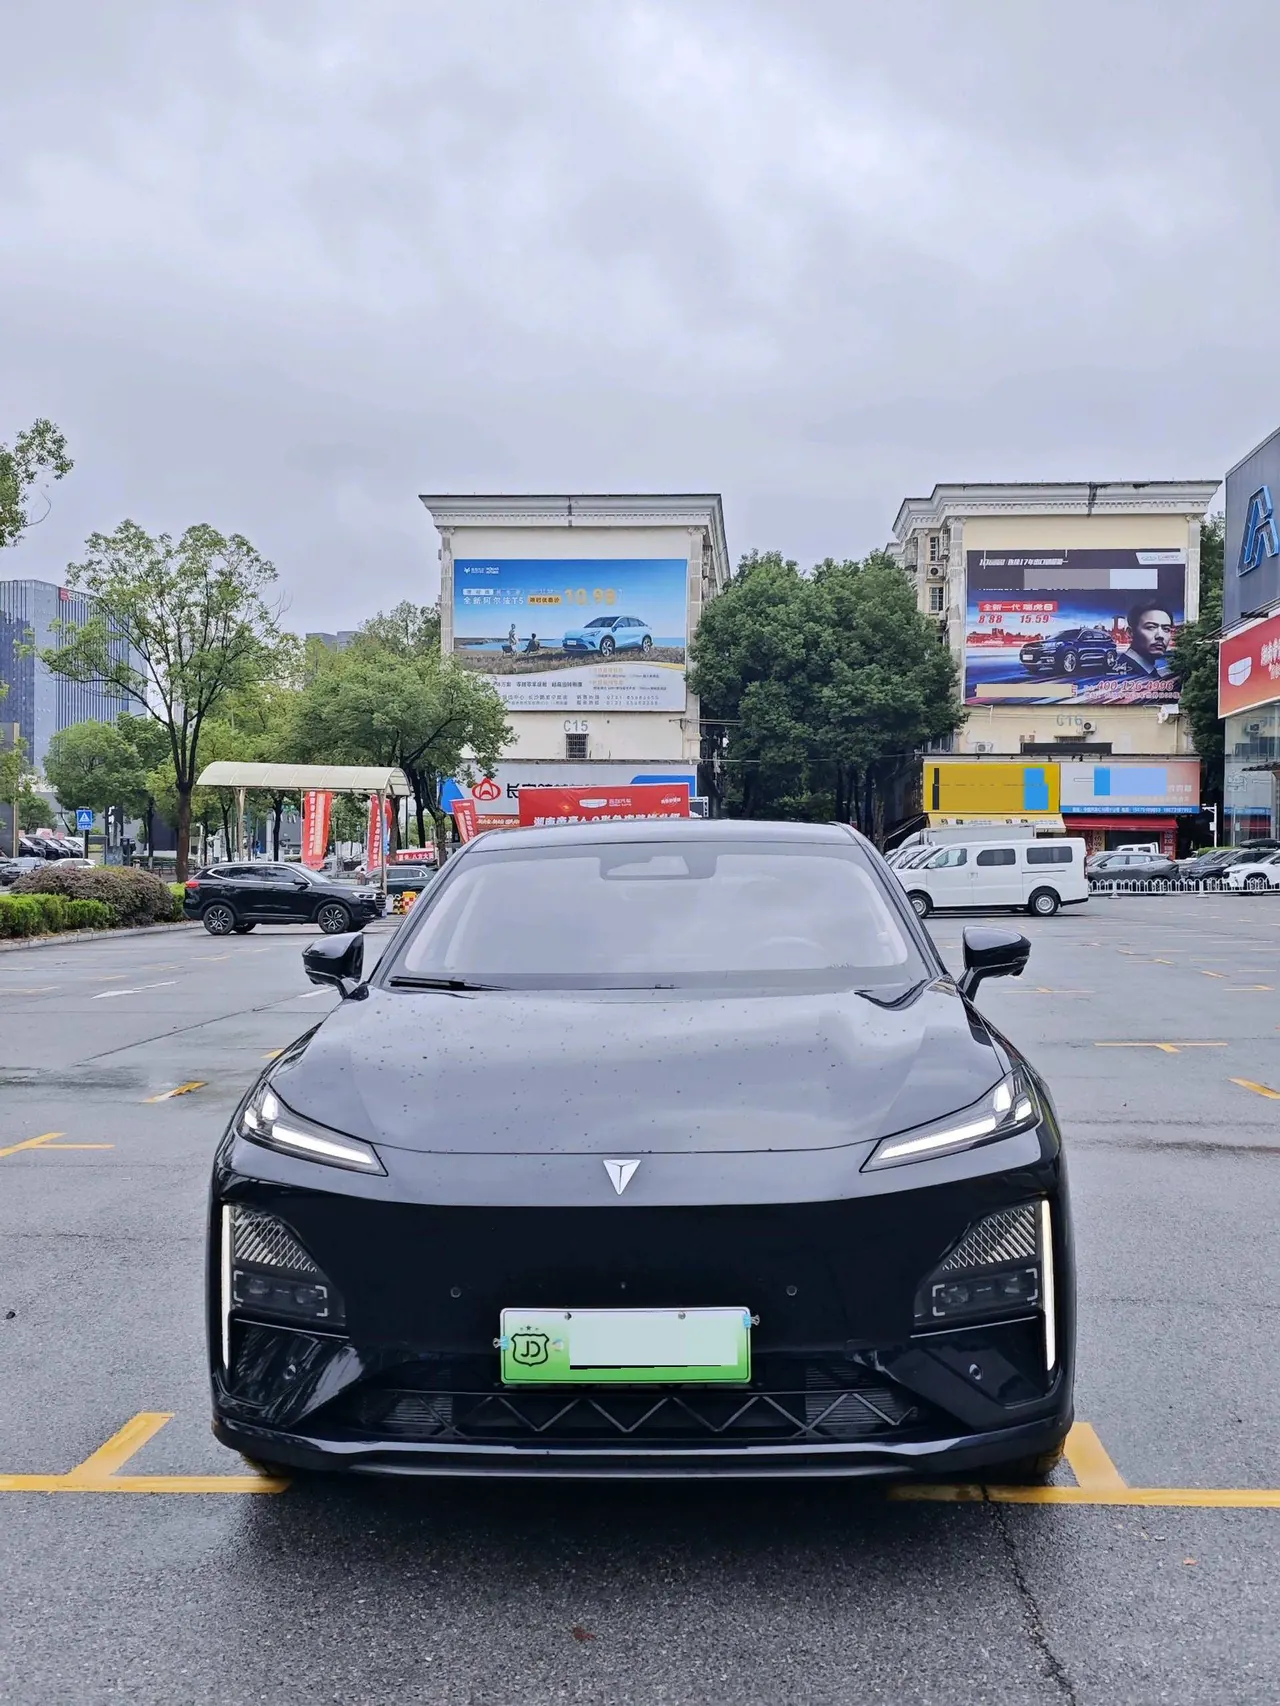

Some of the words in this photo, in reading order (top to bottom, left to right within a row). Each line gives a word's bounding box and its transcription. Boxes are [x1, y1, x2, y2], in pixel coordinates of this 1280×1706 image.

[983, 603, 1021, 611] 全新一代
[563, 719, 589, 732] C15
[521, 1340, 541, 1358] JD
